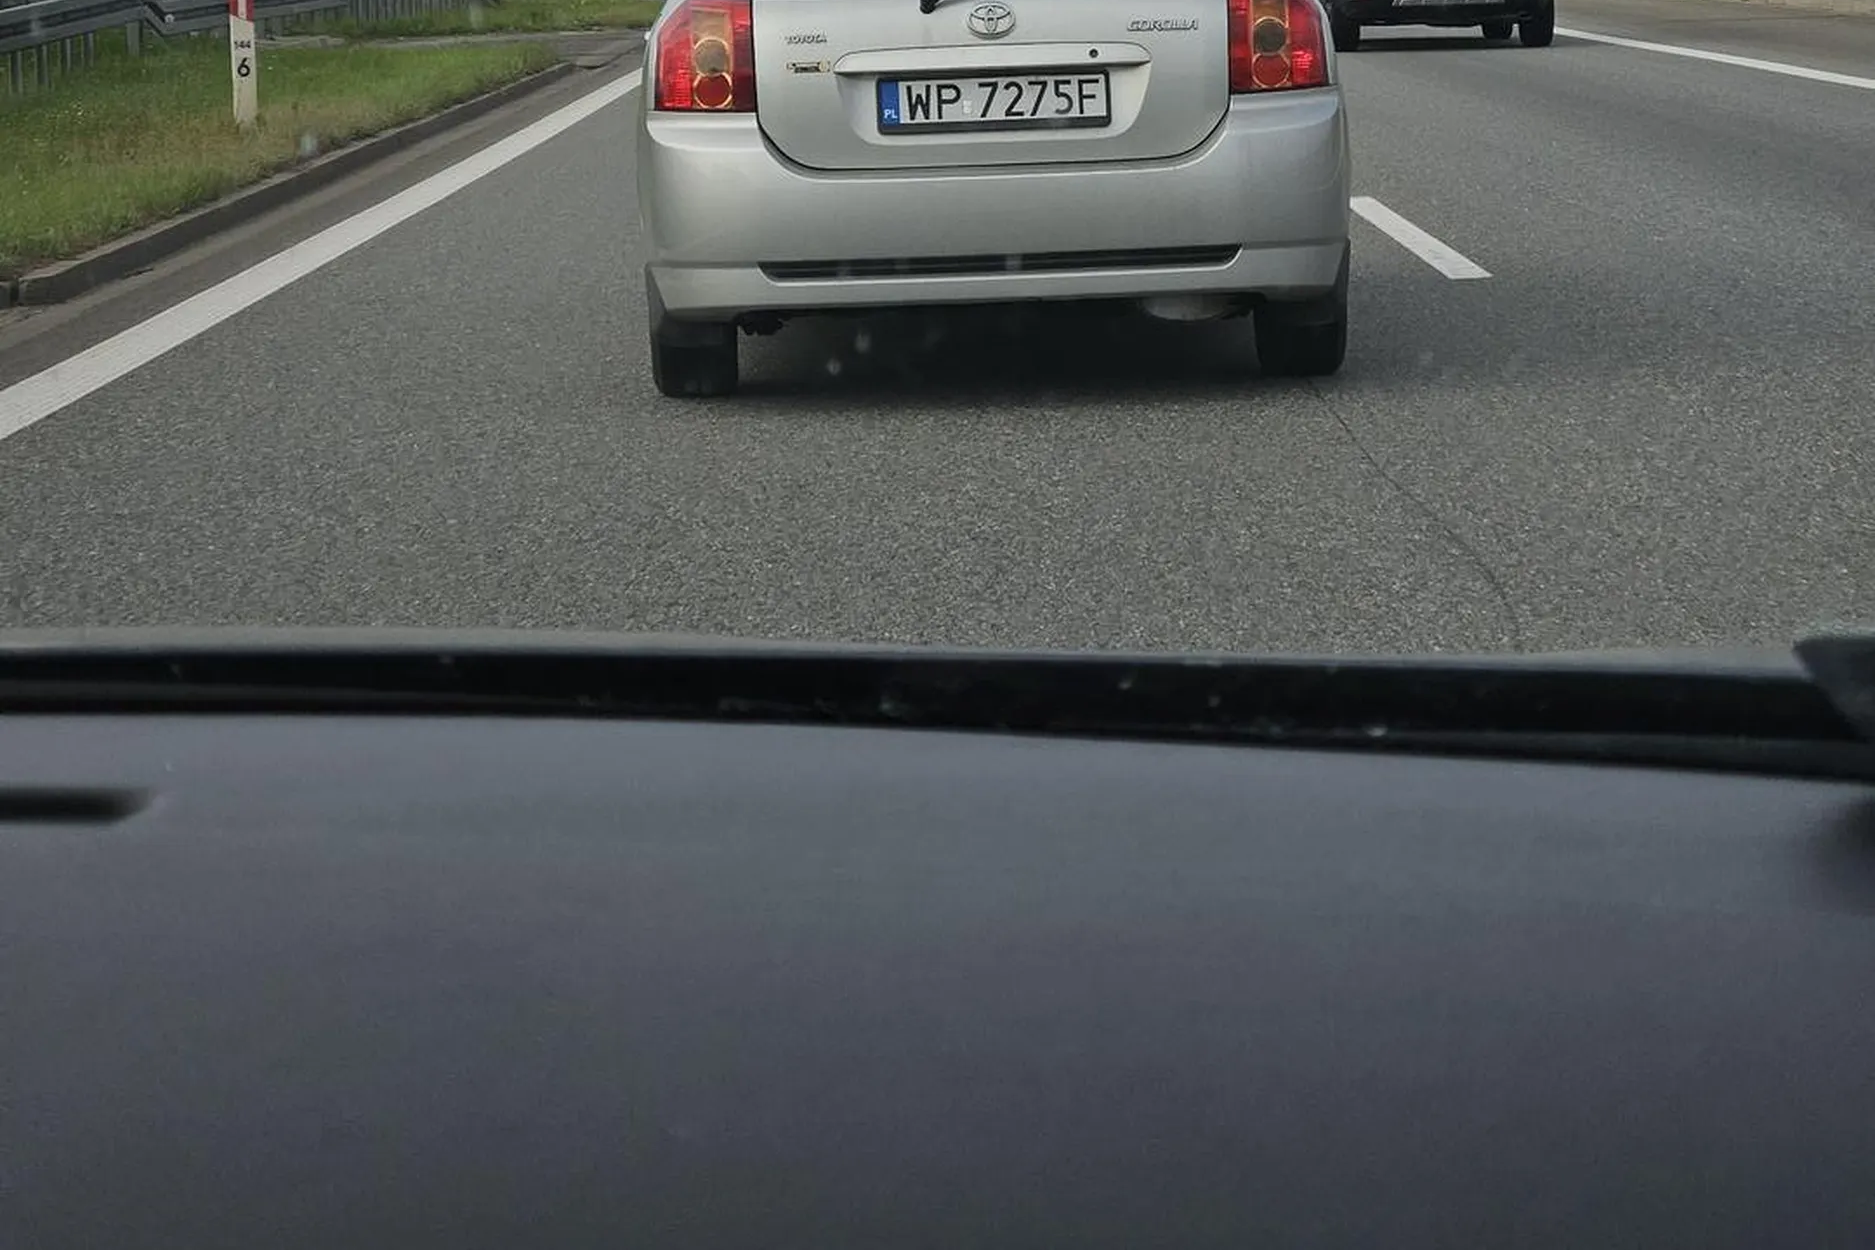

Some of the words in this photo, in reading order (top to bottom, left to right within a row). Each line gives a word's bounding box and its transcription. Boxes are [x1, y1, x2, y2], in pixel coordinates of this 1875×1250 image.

[237, 57, 251, 77] 6
[905, 84, 962, 121] WP
[977, 78, 1101, 119] 7275F
[883, 109, 899, 120] PL
